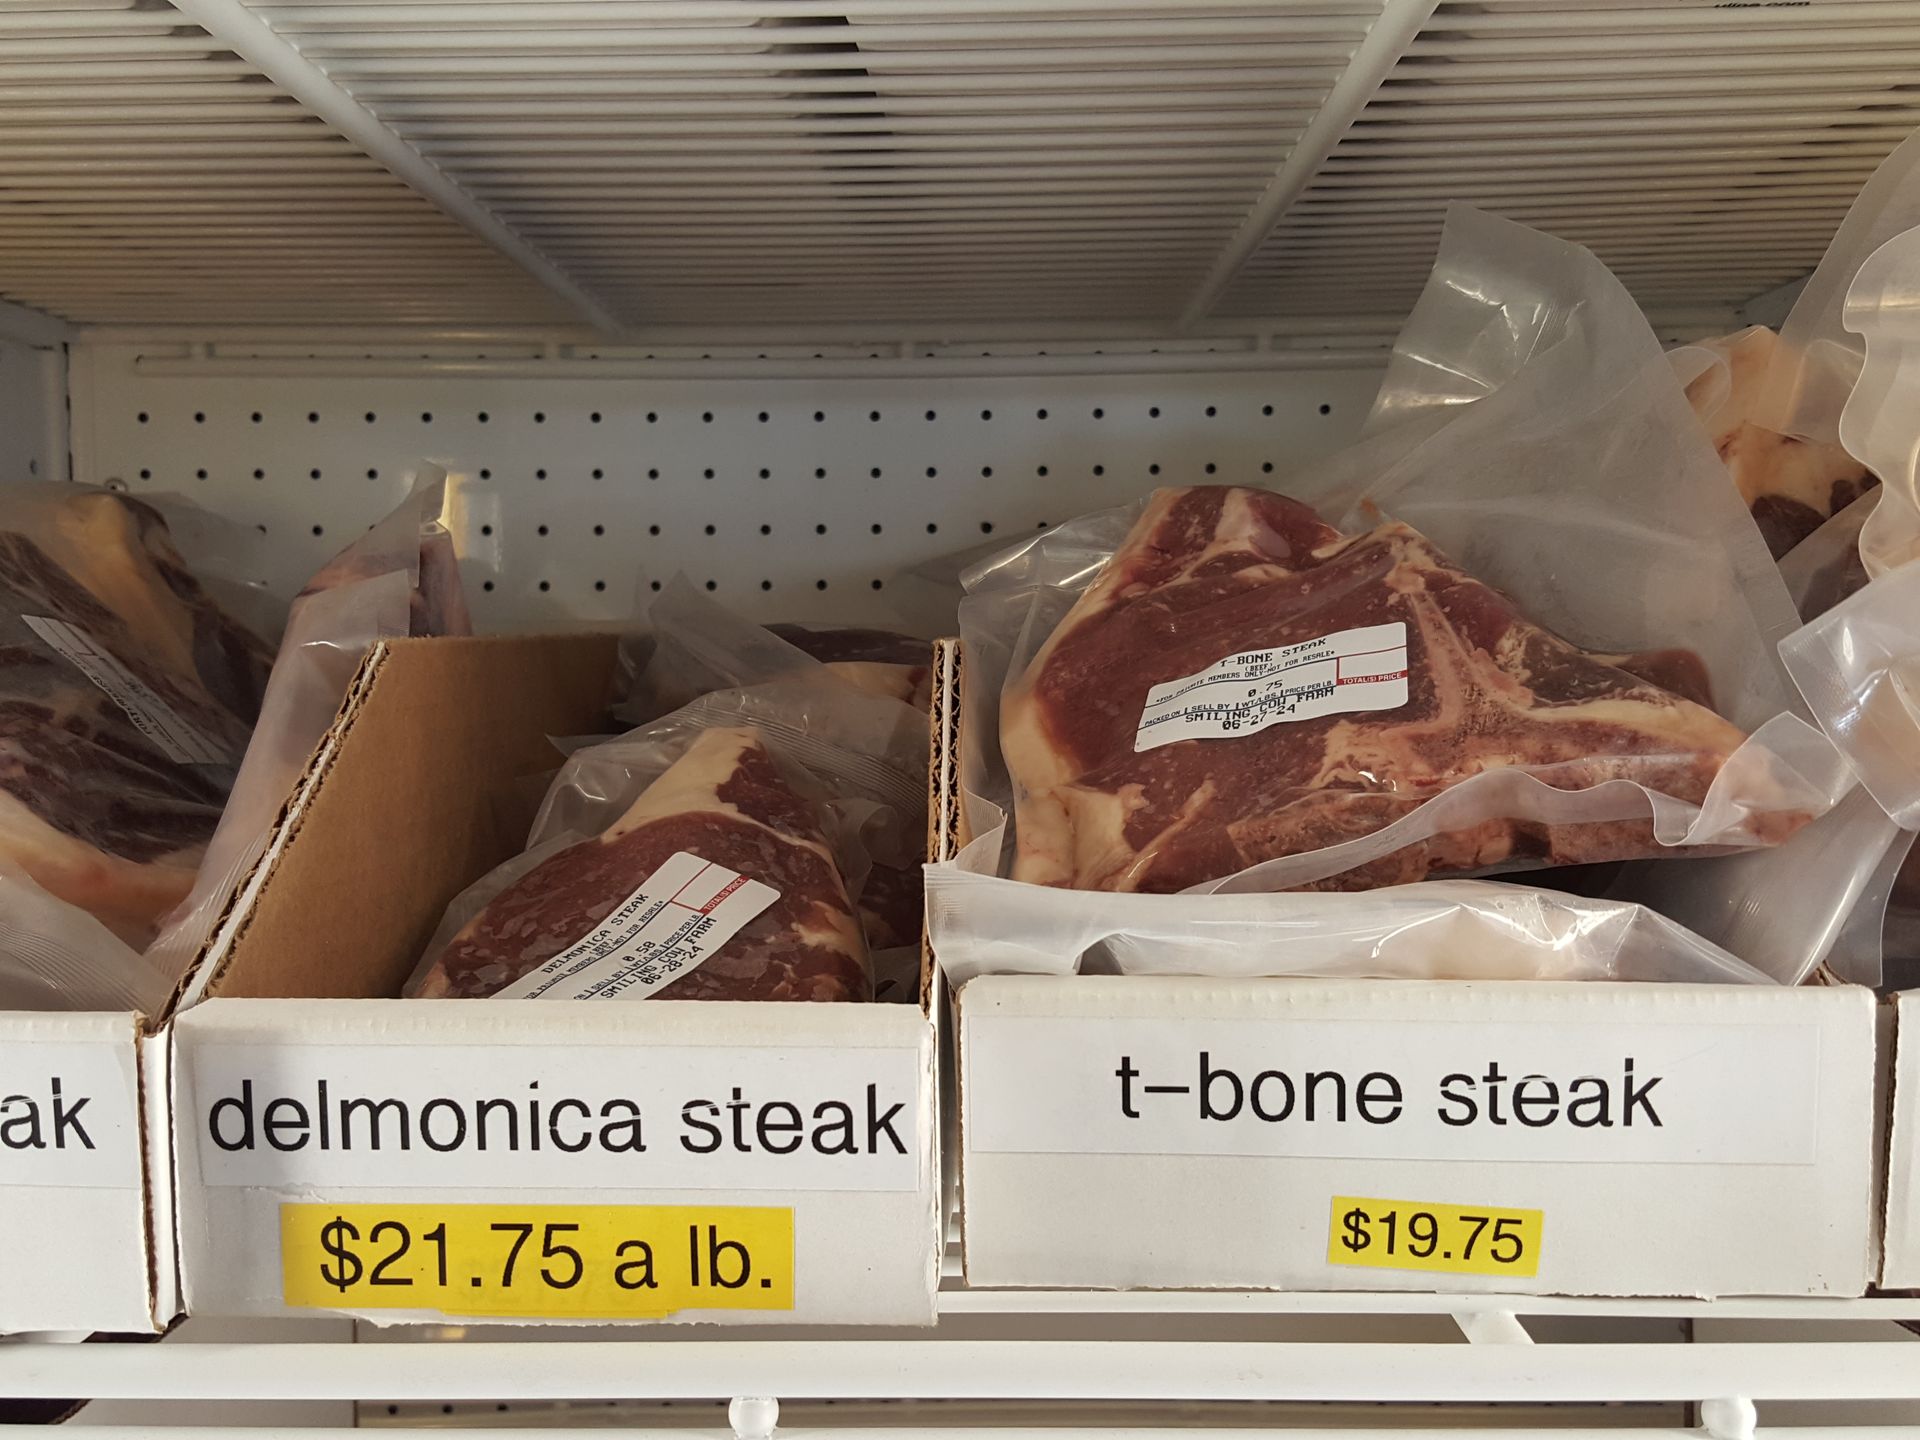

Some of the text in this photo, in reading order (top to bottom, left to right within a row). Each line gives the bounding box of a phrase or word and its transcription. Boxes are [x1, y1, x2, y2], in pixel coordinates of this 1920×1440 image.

[1208, 672, 1240, 683] MEMBERS
[1284, 658, 1299, 668] FOR
[1221, 638, 1327, 667] T-BONE STEAK
[1245, 662, 1273, 672] (BEEF)
[1247, 679, 1283, 698] 0.75
[1342, 672, 1402, 685] TOTAL(S) PRICE
[1144, 713, 1170, 727] PACKED
[1170, 709, 1181, 719] ON
[1191, 704, 1215, 713] SELL
[1217, 703, 1231, 711] BY
[1284, 686, 1306, 695] PRICE
[1307, 683, 1322, 692] PER
[1322, 680, 1335, 688] LB.
[1185, 685, 1335, 723] SMILING COW FARM
[1222, 703, 1296, 730] 06-27-24
[726, 876, 747, 893] PRICE
[541, 893, 650, 974] DELMONICA STEAK
[625, 923, 641, 935] FOR
[591, 977, 613, 991] SELL
[611, 969, 625, 980] BY
[663, 932, 680, 947] PRICE
[678, 920, 693, 934] PER
[600, 916, 718, 999] SMILING COW FARM
[622, 940, 656, 963] 0.58
[640, 945, 705, 986] 06-28-24
[1115, 1051, 1663, 1128] t-bone steak
[0, 1077, 95, 1150] ak
[208, 1079, 908, 1155] delmonica steak
[320, 1215, 772, 1293] $21.75 a lb.
[1341, 1207, 1523, 1263] $19.75
